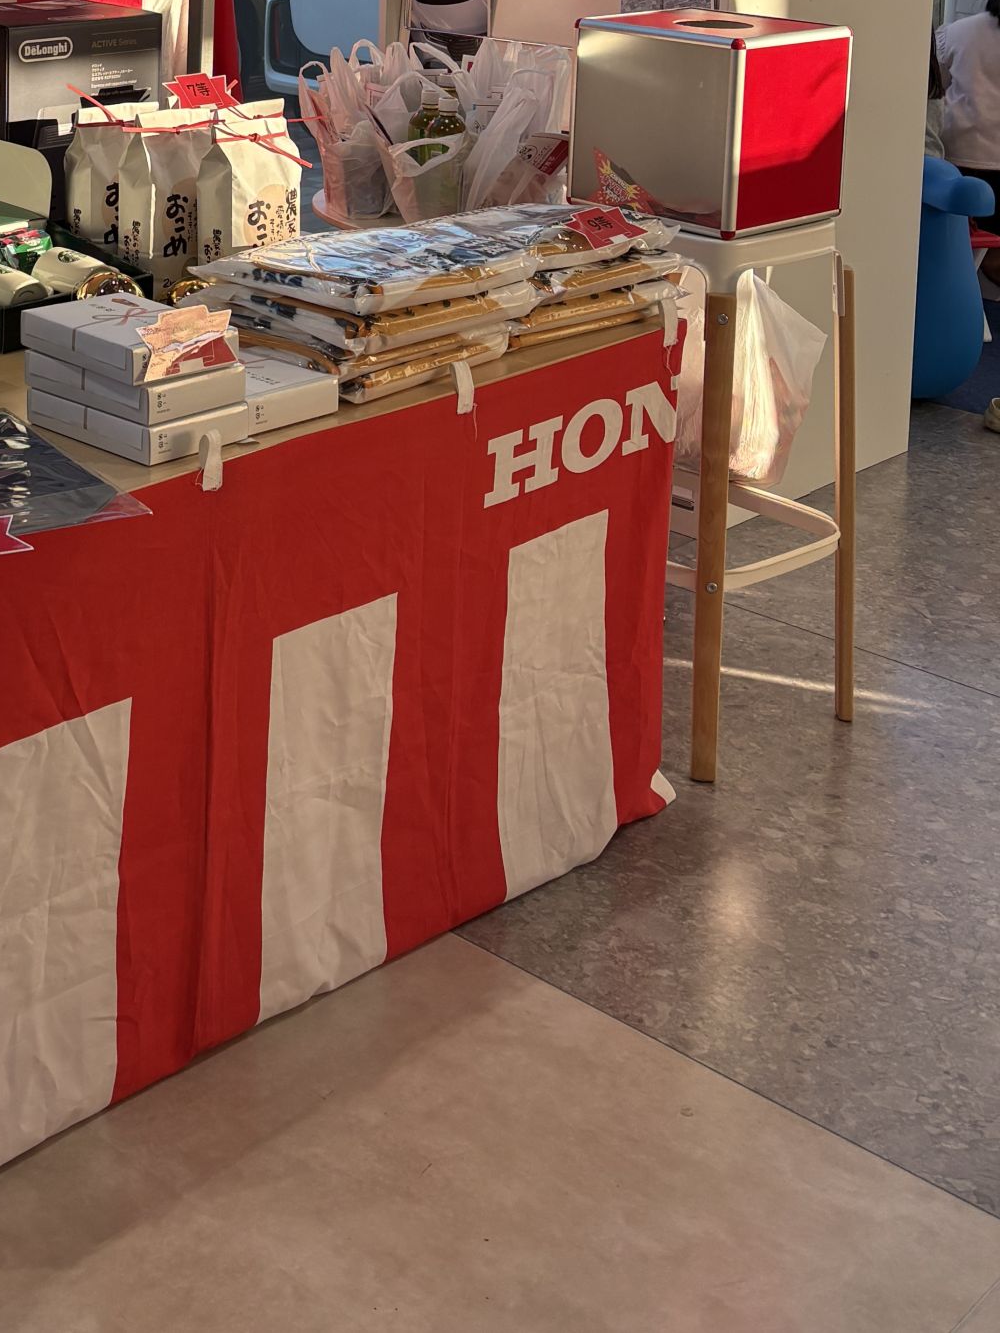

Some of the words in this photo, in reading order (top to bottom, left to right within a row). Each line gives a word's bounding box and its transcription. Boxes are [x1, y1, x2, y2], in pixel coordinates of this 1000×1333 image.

[91, 39, 117, 49] ACTIVE
[186, 82, 210, 98] 7等
[163, 193, 189, 259] おこめ
[247, 200, 272, 249] おこ
[587, 215, 613, 231] 9等
